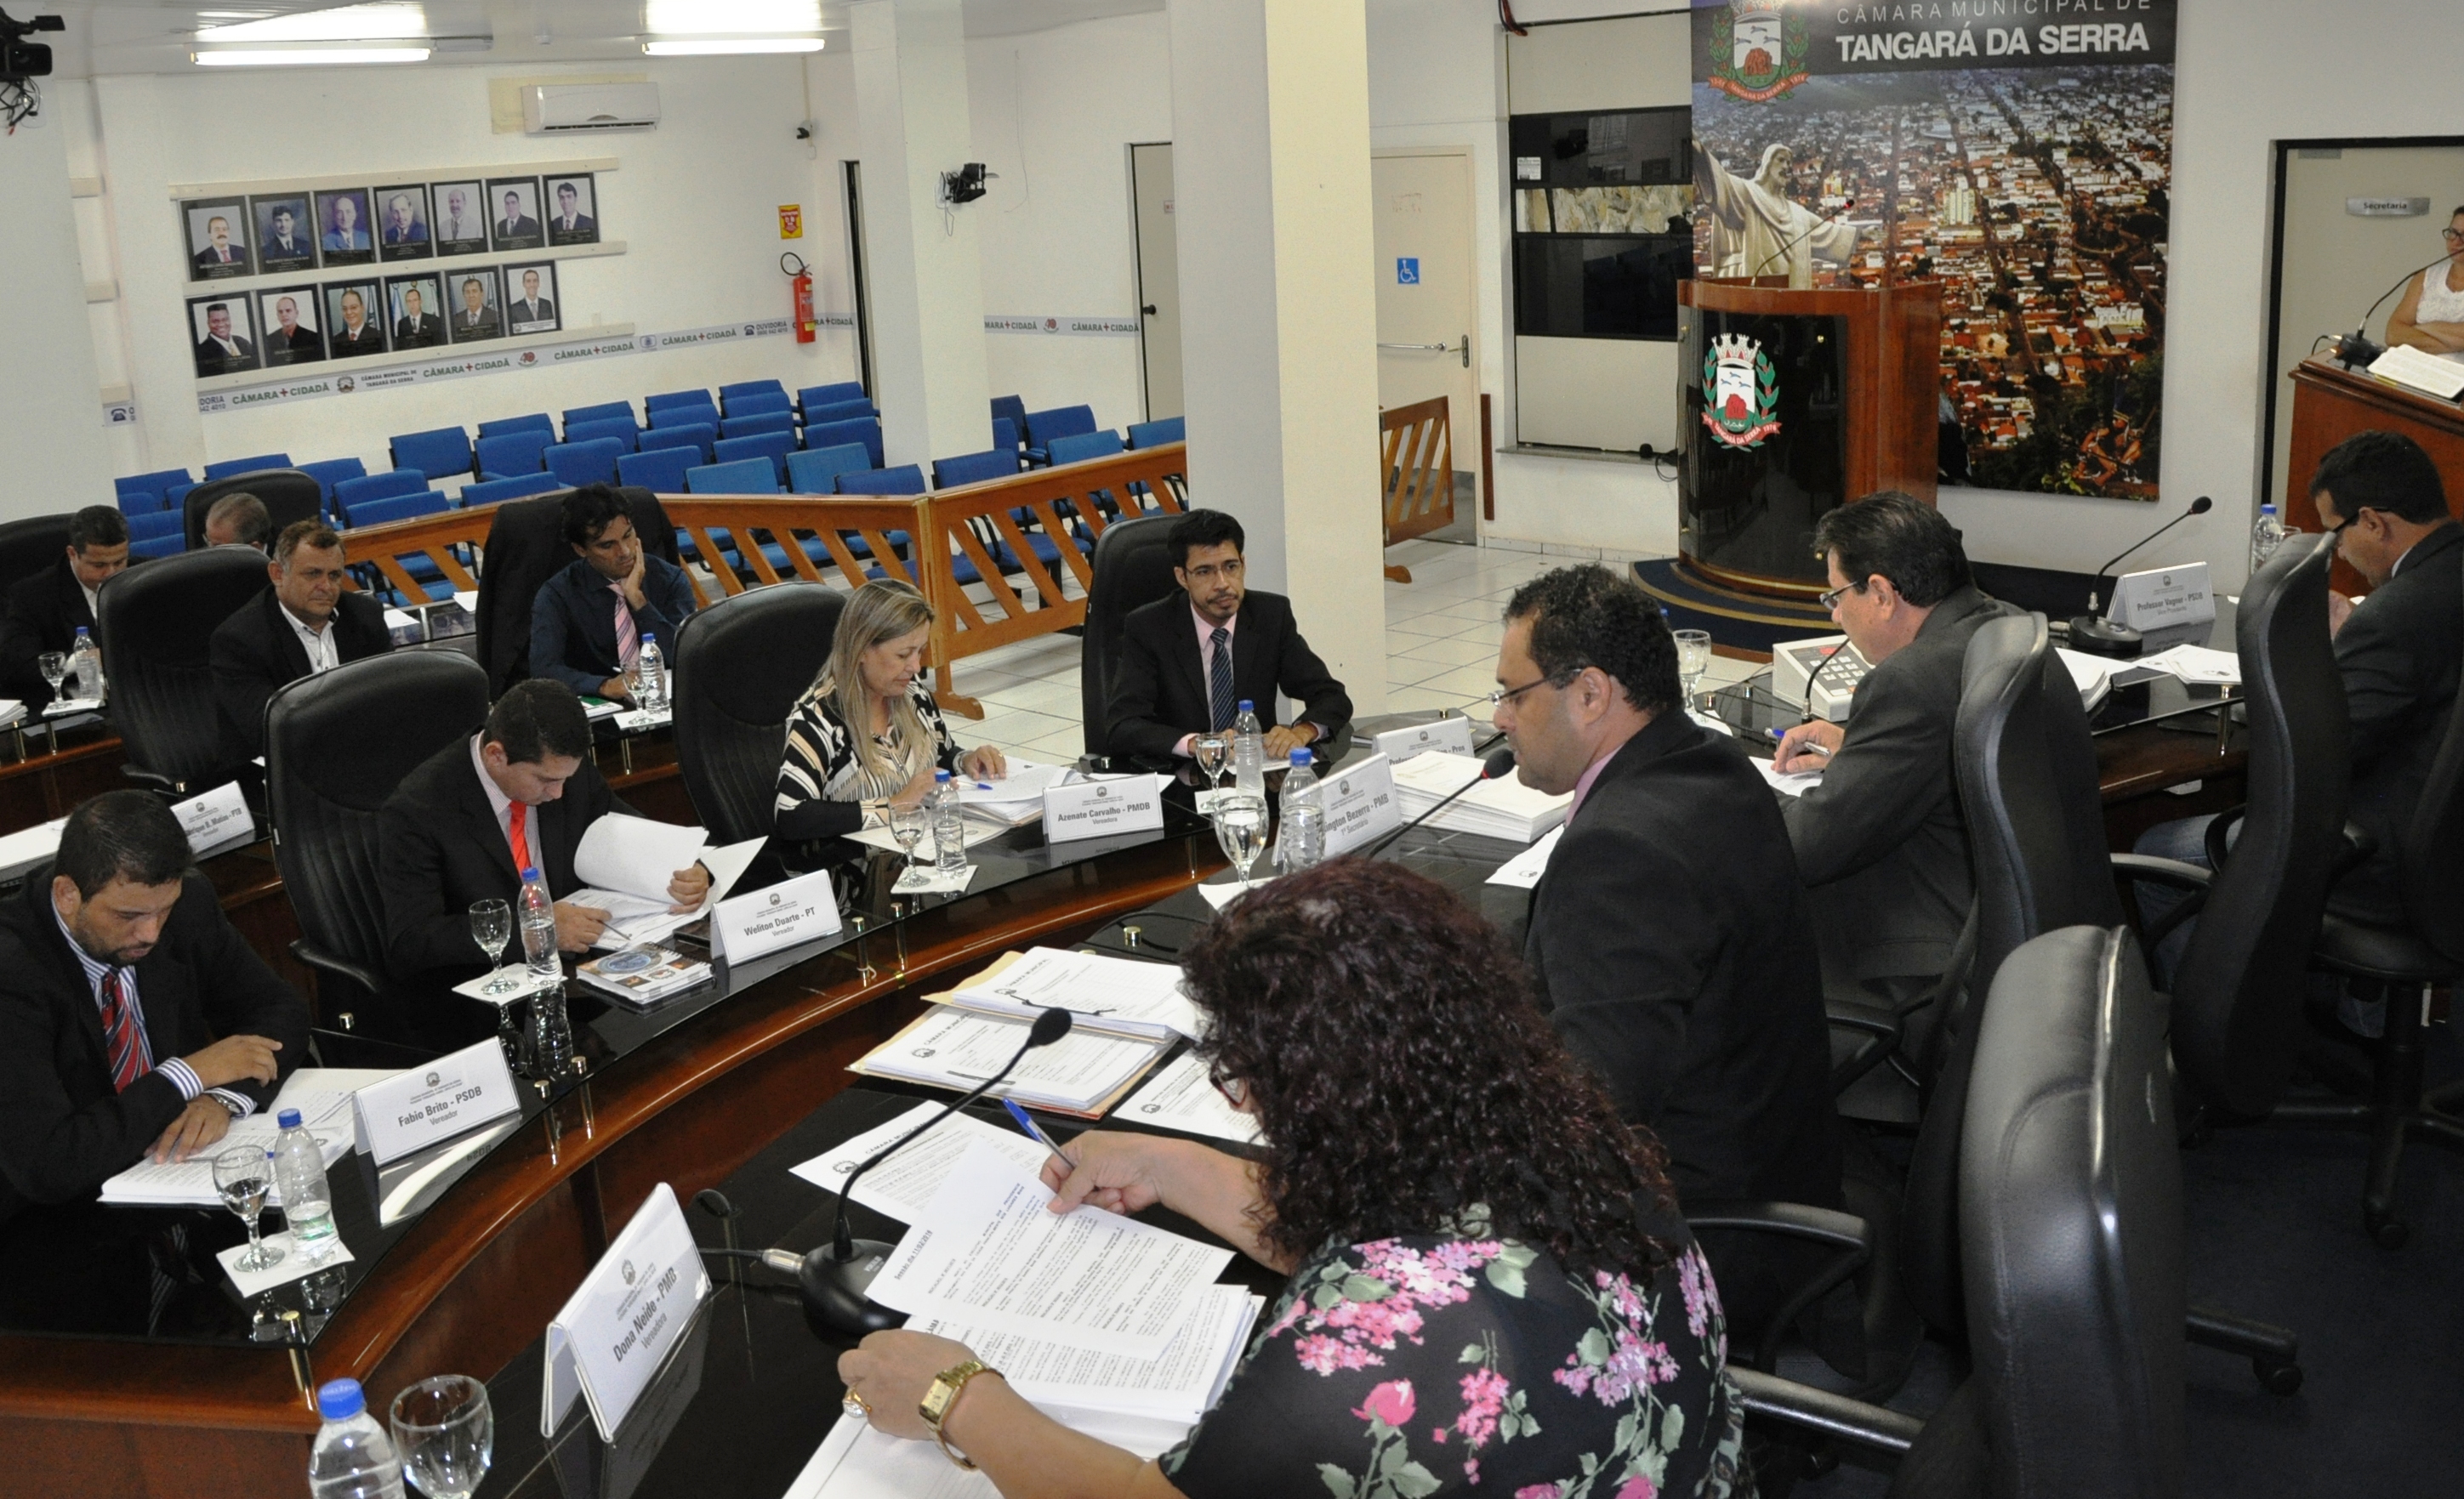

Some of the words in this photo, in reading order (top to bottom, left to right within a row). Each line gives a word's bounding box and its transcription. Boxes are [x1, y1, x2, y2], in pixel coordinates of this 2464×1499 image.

[1836, 3, 1943, 24] CÂMARA
[1952, 0, 2105, 17] MUNICIPAL
[2117, 0, 2151, 10] DE
[1835, 20, 1978, 62] TANGARÁ
[1986, 27, 2031, 56] DA
[2039, 22, 2151, 54] SERRA
[2363, 202, 2408, 210] Secretaria
[756, 321, 788, 330] OUVIDORIA
[1057, 812, 1088, 822] Azenate
[1089, 807, 1121, 818] Carvalho
[1127, 802, 1151, 813] PMDB
[1346, 804, 1371, 822] Bezerra
[1373, 792, 1389, 809] PMB
[1092, 816, 1118, 825] Vereadora
[775, 913, 800, 927] Duarte
[805, 906, 815, 917] PT
[771, 925, 794, 937] Vereador
[398, 1110, 424, 1127] Fabio
[425, 1101, 449, 1116] Brito
[455, 1086, 482, 1104] PSDB
[429, 1110, 458, 1126] Vereador
[613, 1330, 637, 1363] Dona
[633, 1301, 657, 1335] Neide
[640, 1312, 668, 1349] Vereadora
